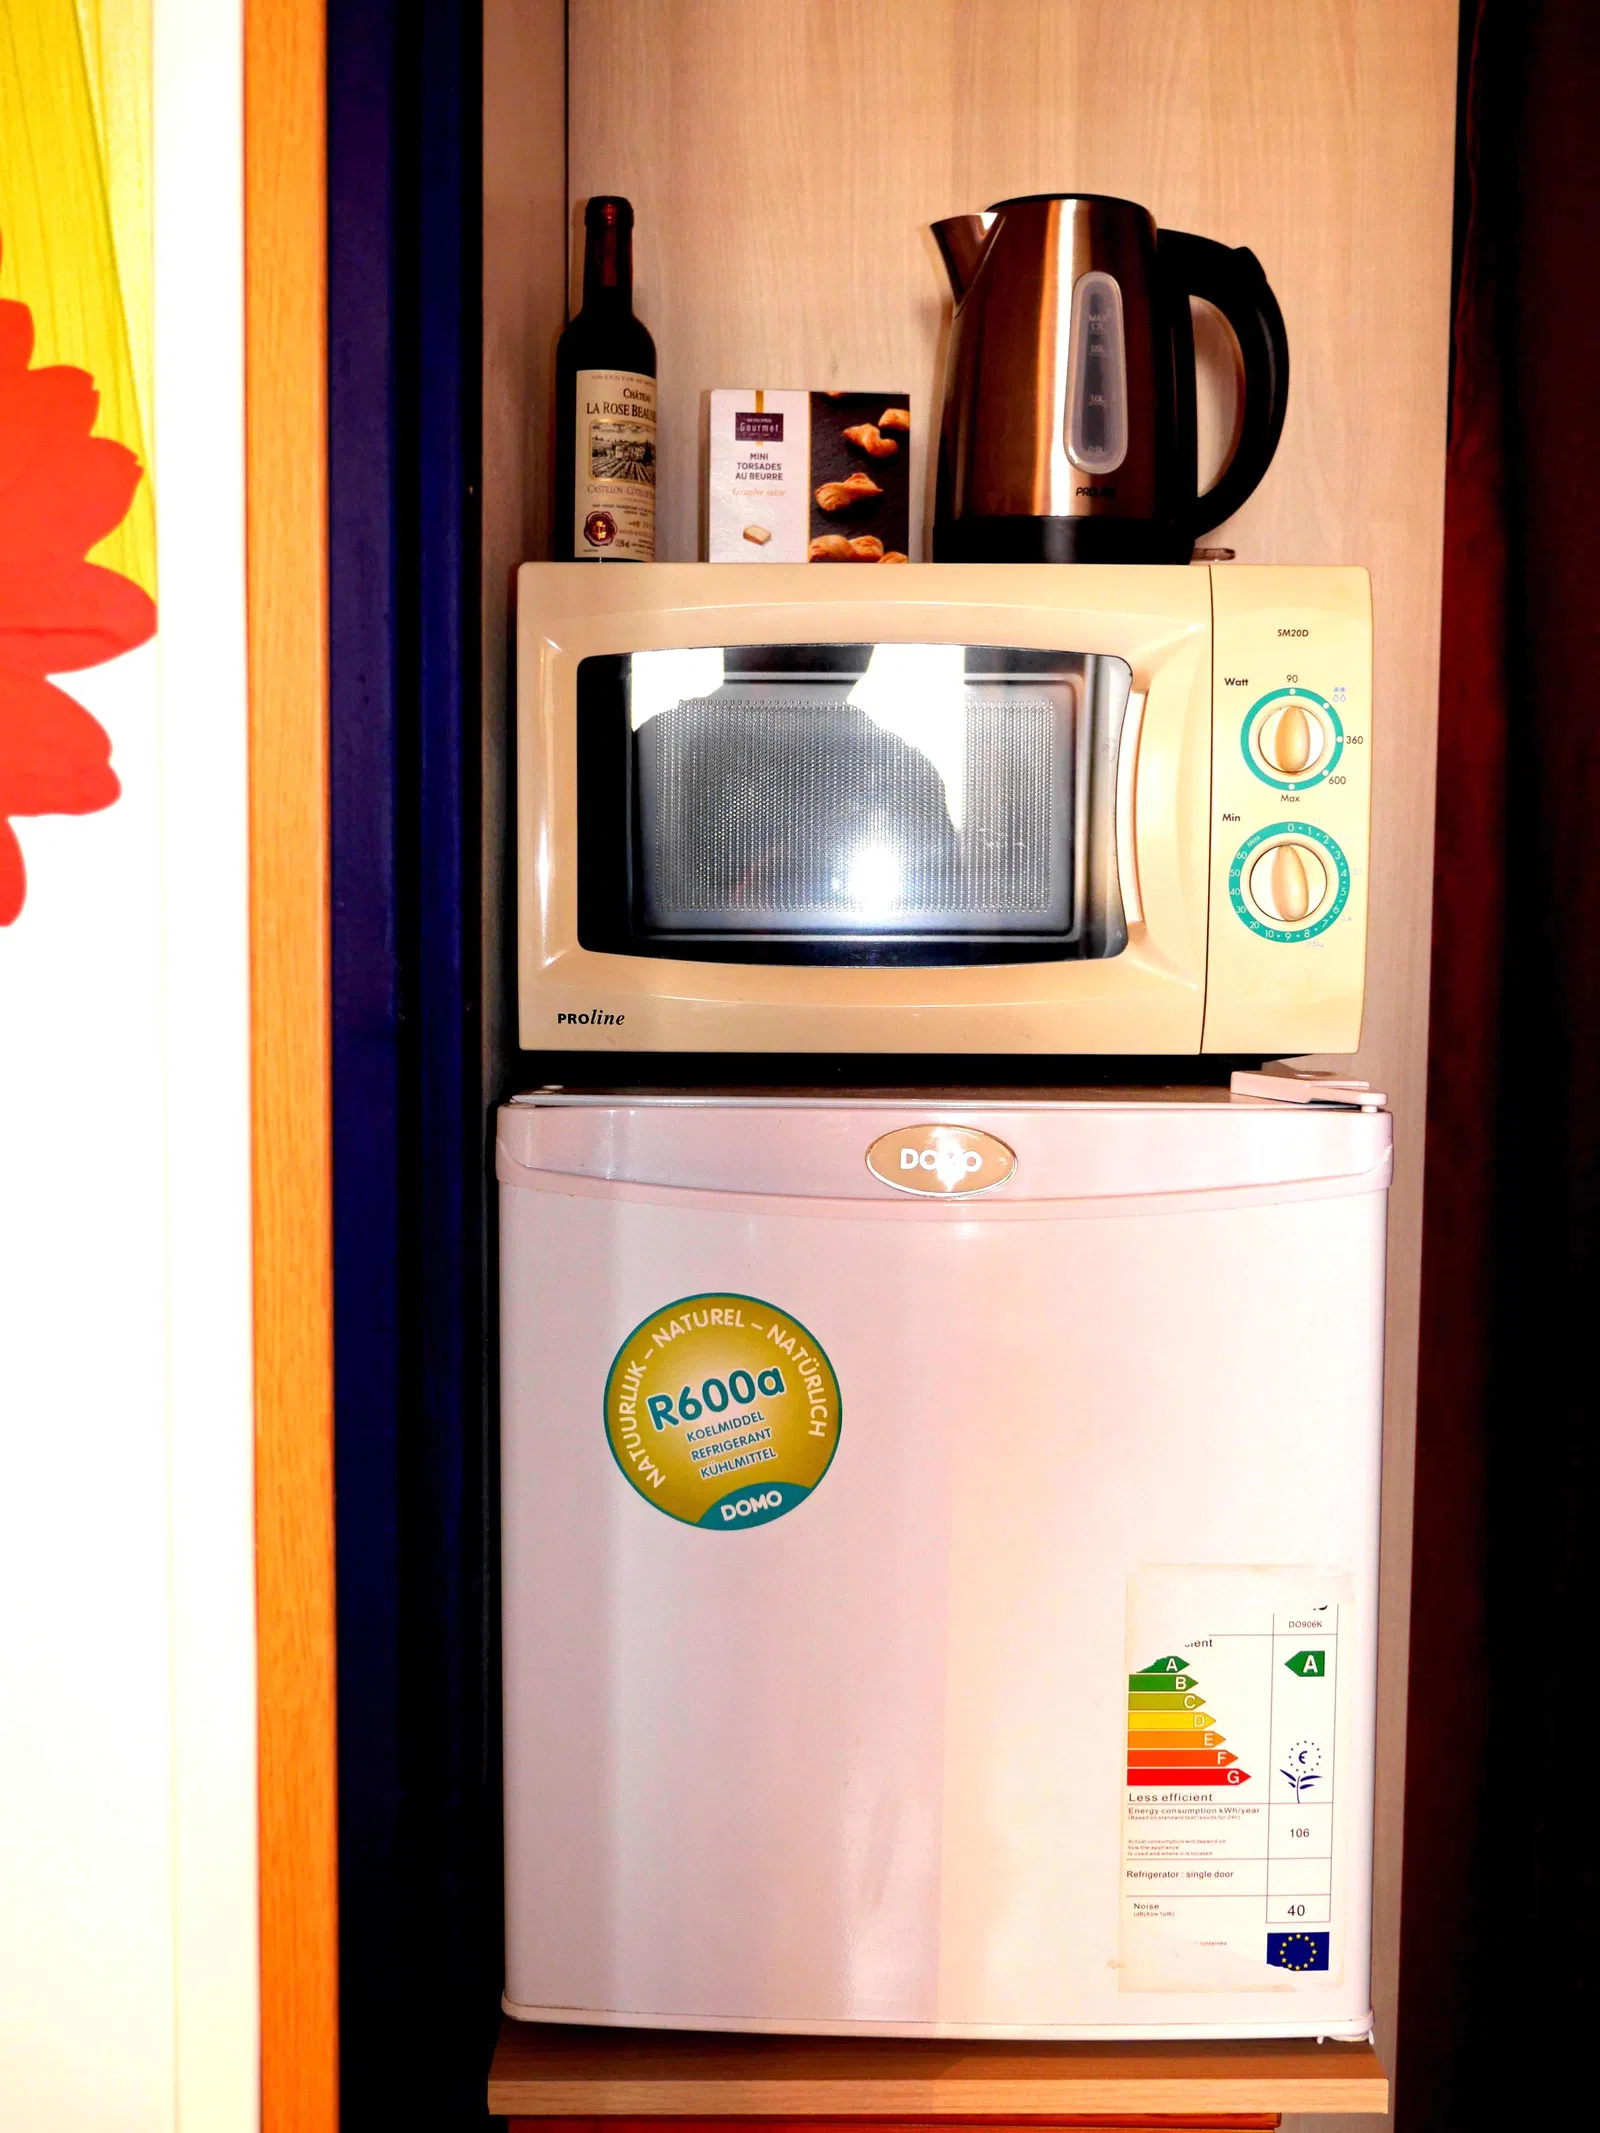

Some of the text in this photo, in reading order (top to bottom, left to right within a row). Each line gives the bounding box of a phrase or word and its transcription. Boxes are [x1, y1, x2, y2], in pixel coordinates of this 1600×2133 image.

[586, 402, 600, 415] LA
[603, 402, 630, 416] ROSE
[740, 422, 779, 432] Gourmet
[749, 453, 769, 461] MINI
[737, 463, 782, 471] TORSADES
[735, 472, 747, 480] AU
[1277, 629, 1309, 637] SM20D
[1224, 677, 1249, 686] Watt
[1286, 674, 1299, 683] 90
[1346, 736, 1363, 744] 360
[1328, 776, 1347, 785] 600
[1280, 794, 1300, 802] Max
[1222, 813, 1241, 821] Min
[1229, 823, 1347, 941] 0 1 2 3 4 5 6 7 8 9 10 20 30 40 50 60 Mins
[557, 1008, 625, 1025] PROline
[900, 1148, 983, 1173] DOO
[618, 1361, 666, 1488] NATUURLIJK
[651, 1308, 745, 1348] NATUREL
[766, 1324, 828, 1438] NATÜRLICH
[647, 1366, 785, 1431] R600a
[686, 1411, 765, 1443] KOELMIDDEL
[691, 1427, 772, 1461] REFRIGERANT
[700, 1447, 777, 1479] KÜHLMITTEL
[720, 1490, 783, 1521] DOMO
[1165, 1658, 1178, 1672] A
[1303, 1655, 1318, 1674] A
[1175, 1677, 1187, 1690] B
[1184, 1695, 1196, 1709] C
[1194, 1715, 1206, 1727] D
[1204, 1733, 1214, 1746] E
[1217, 1752, 1227, 1764] F
[1227, 1770, 1240, 1784] G
[1128, 1793, 1213, 1802] Less efficient
[1128, 1806, 1260, 1815] Energy consumption kWh/year
[1289, 1829, 1310, 1838] 106
[1126, 1870, 1179, 1879] Refrigerator
[1186, 1870, 1212, 1879] single
[1214, 1870, 1234, 1878] door
[1287, 1904, 1306, 1916] 40
